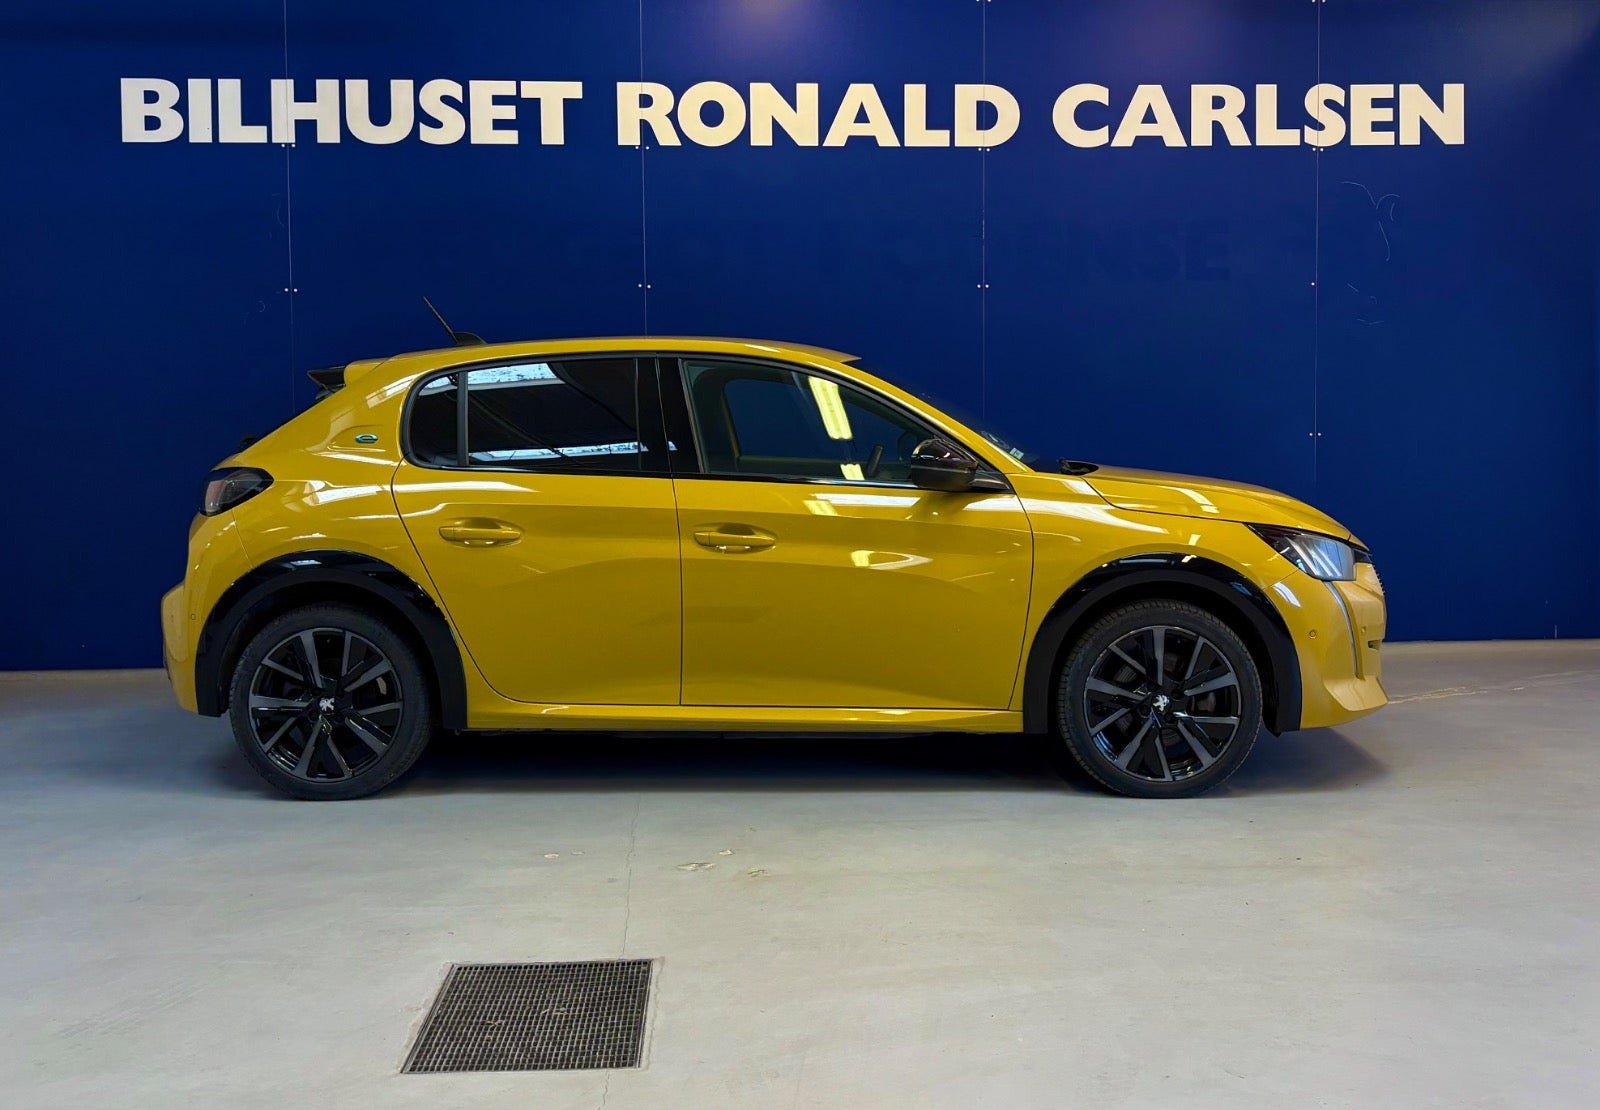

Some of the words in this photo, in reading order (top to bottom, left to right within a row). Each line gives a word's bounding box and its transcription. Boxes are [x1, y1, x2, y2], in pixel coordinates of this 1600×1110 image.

[120, 78, 583, 146] BILHUSET
[616, 81, 1021, 149] RONALD
[1052, 82, 1466, 149] CARLSEN
